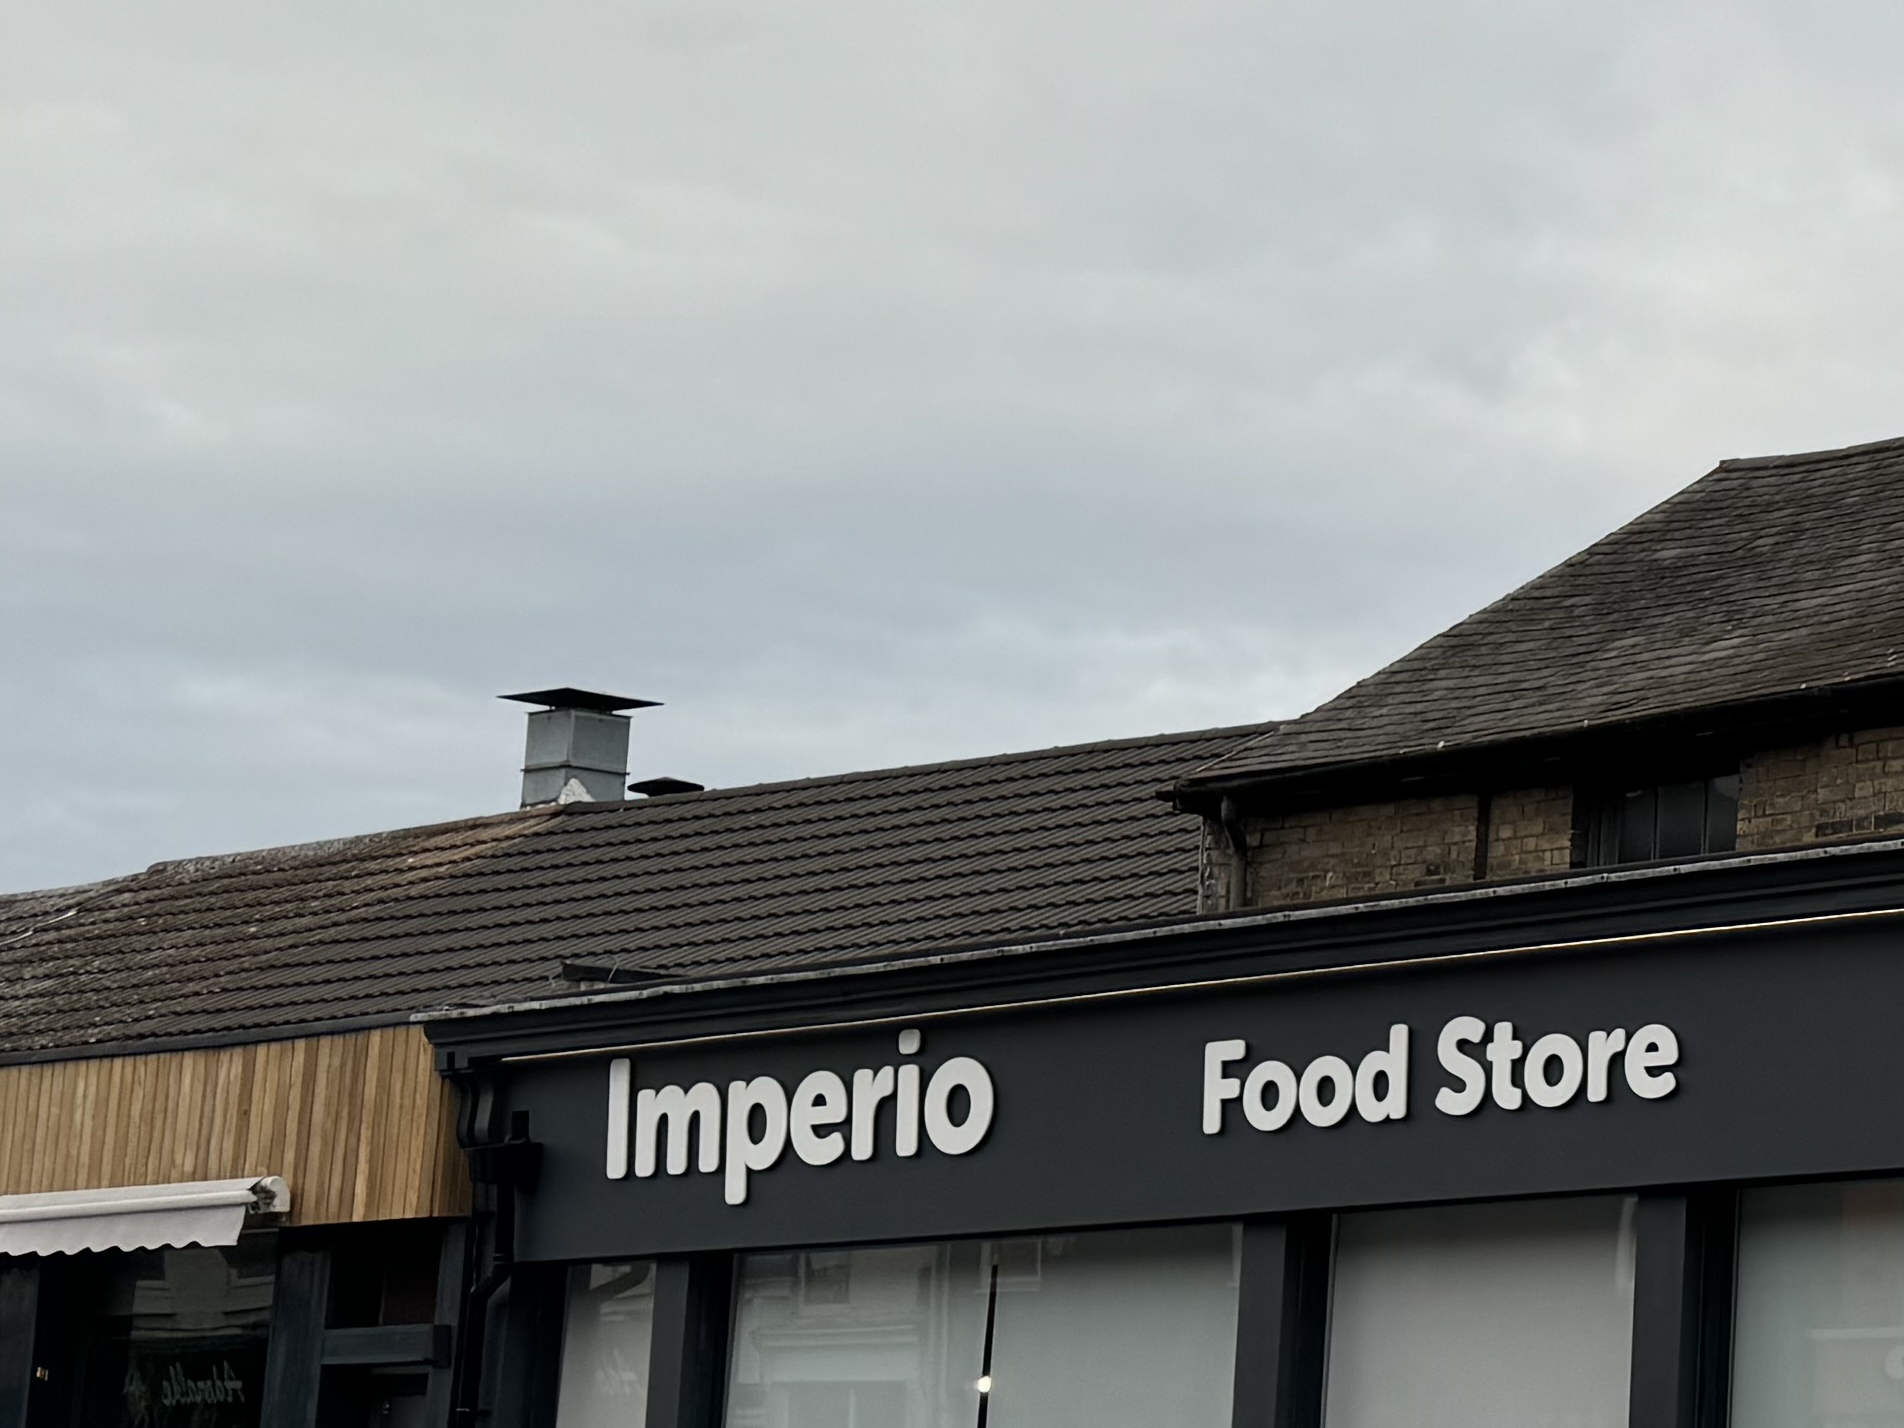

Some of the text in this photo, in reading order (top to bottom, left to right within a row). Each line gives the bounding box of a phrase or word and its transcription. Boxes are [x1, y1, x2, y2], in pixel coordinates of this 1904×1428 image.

[605, 1028, 995, 1205] Imperio
[1202, 1014, 1679, 1136] Food Store
